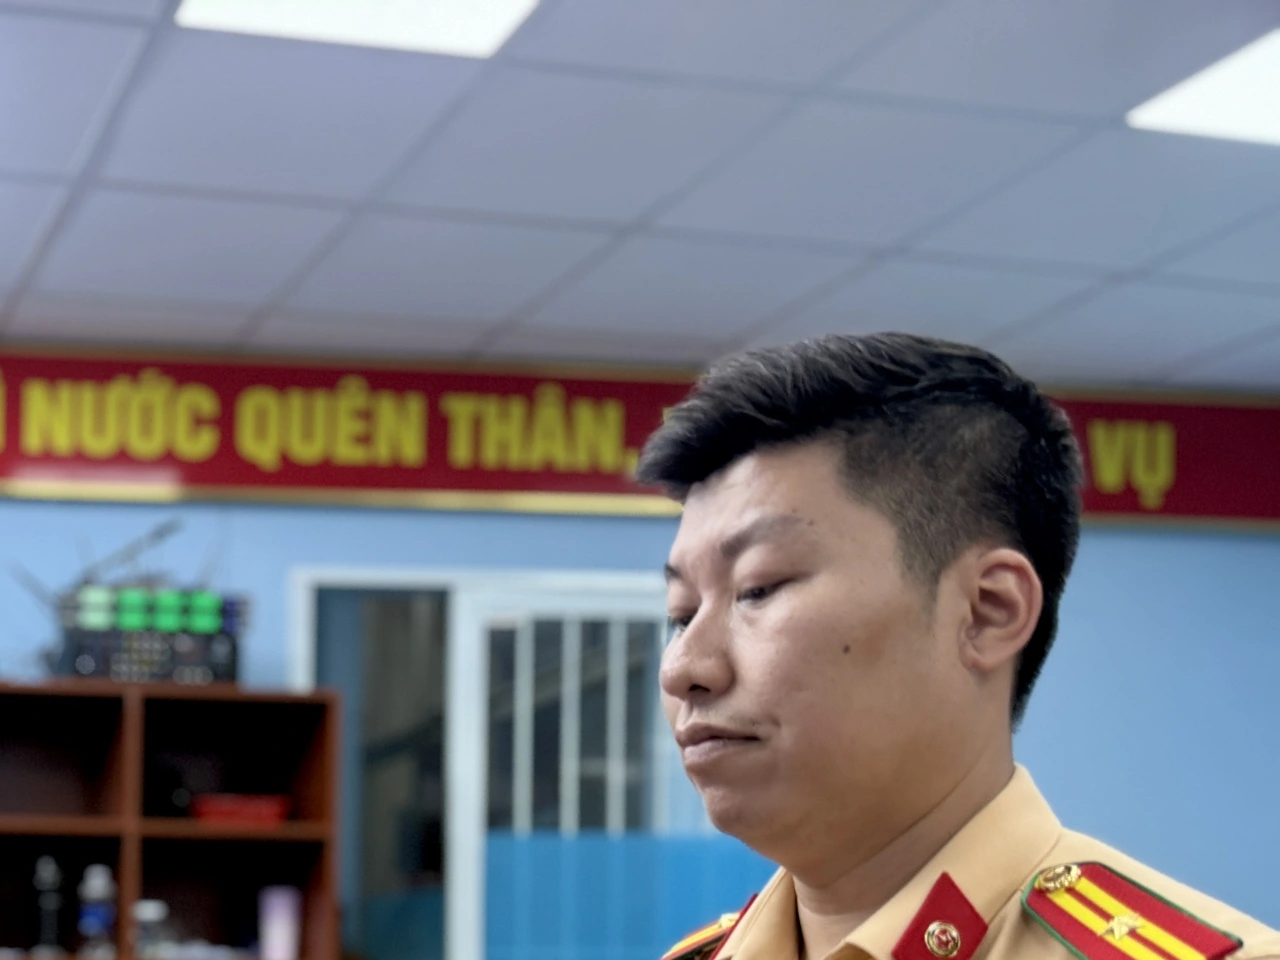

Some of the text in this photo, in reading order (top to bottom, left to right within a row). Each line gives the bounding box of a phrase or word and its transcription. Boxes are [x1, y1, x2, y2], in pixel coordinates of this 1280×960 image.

[21, 366, 220, 462] NƯỚC
[234, 373, 428, 473] QUÊN
[1086, 417, 1177, 511] VỤ
